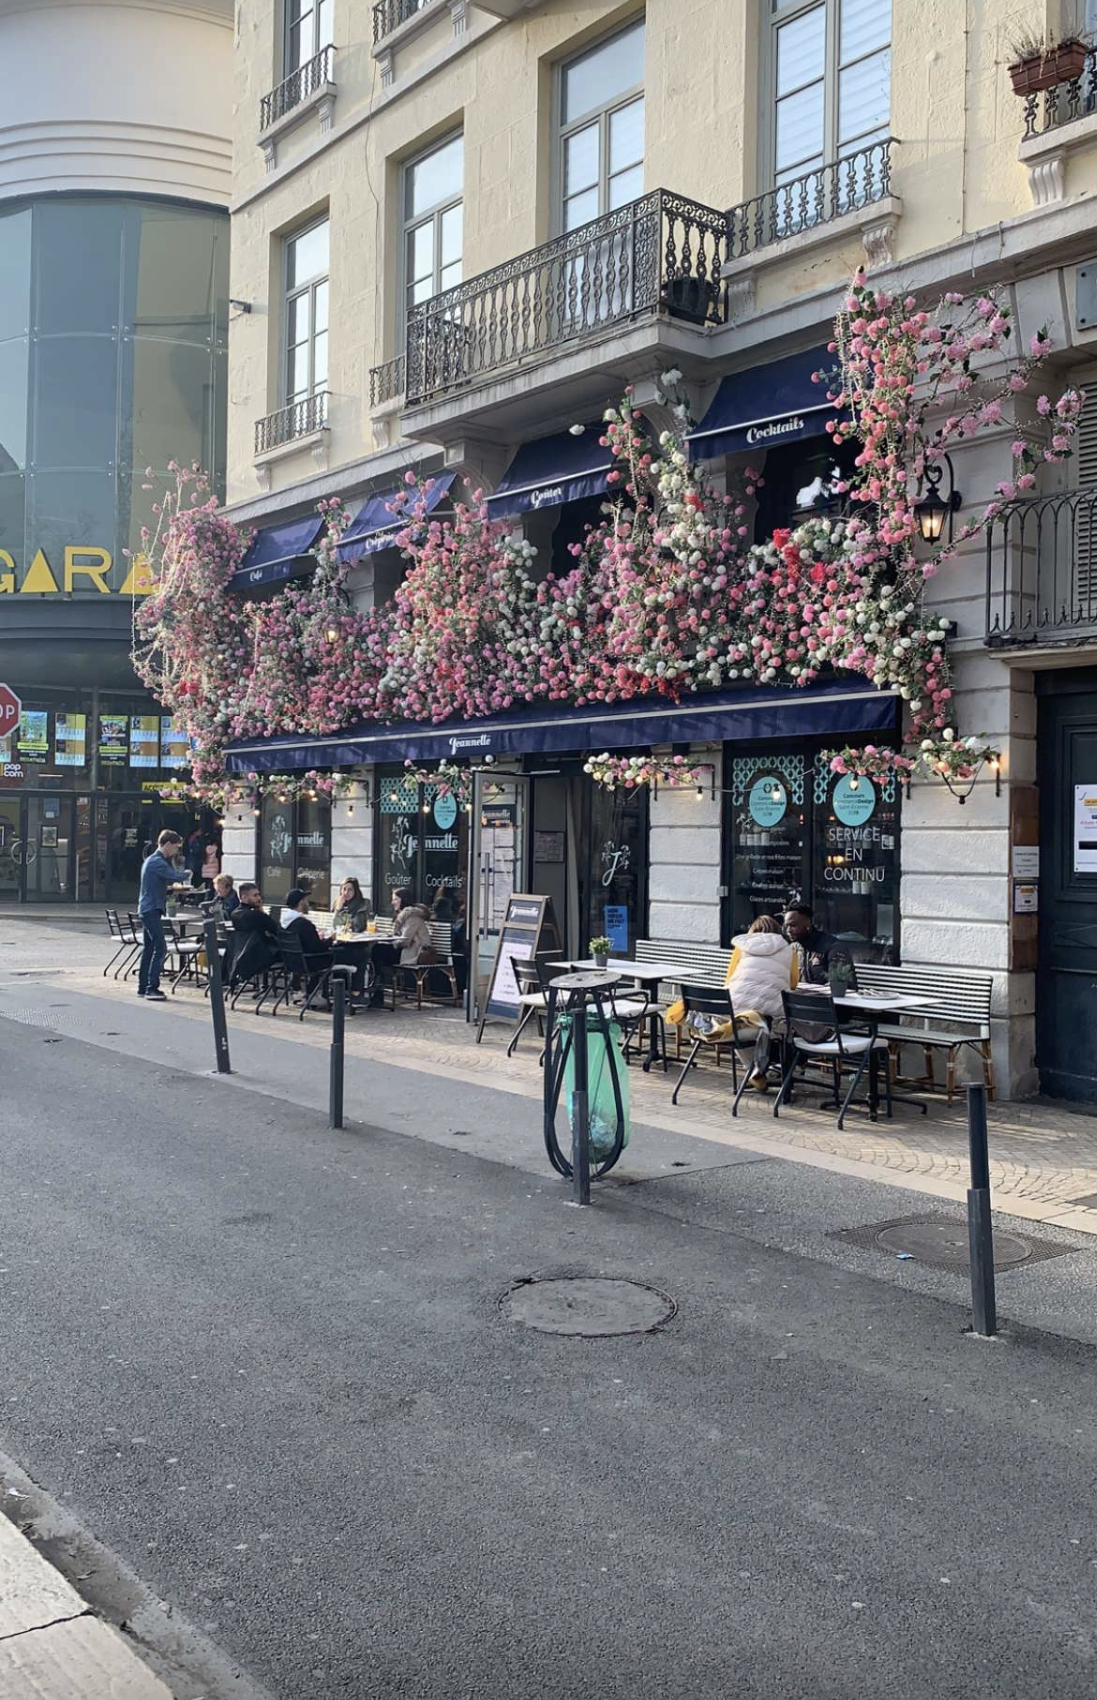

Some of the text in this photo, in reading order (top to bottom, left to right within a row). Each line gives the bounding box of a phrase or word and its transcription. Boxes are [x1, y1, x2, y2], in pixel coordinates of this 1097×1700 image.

[746, 416, 804, 444] Cocktails
[4, 763, 21, 772] pop
[829, 827, 881, 842] SERVICE
[845, 847, 863, 861] EN
[385, 872, 411, 885] Goûter
[425, 873, 463, 888] Cocktails
[824, 866, 885, 881] CONTINU
